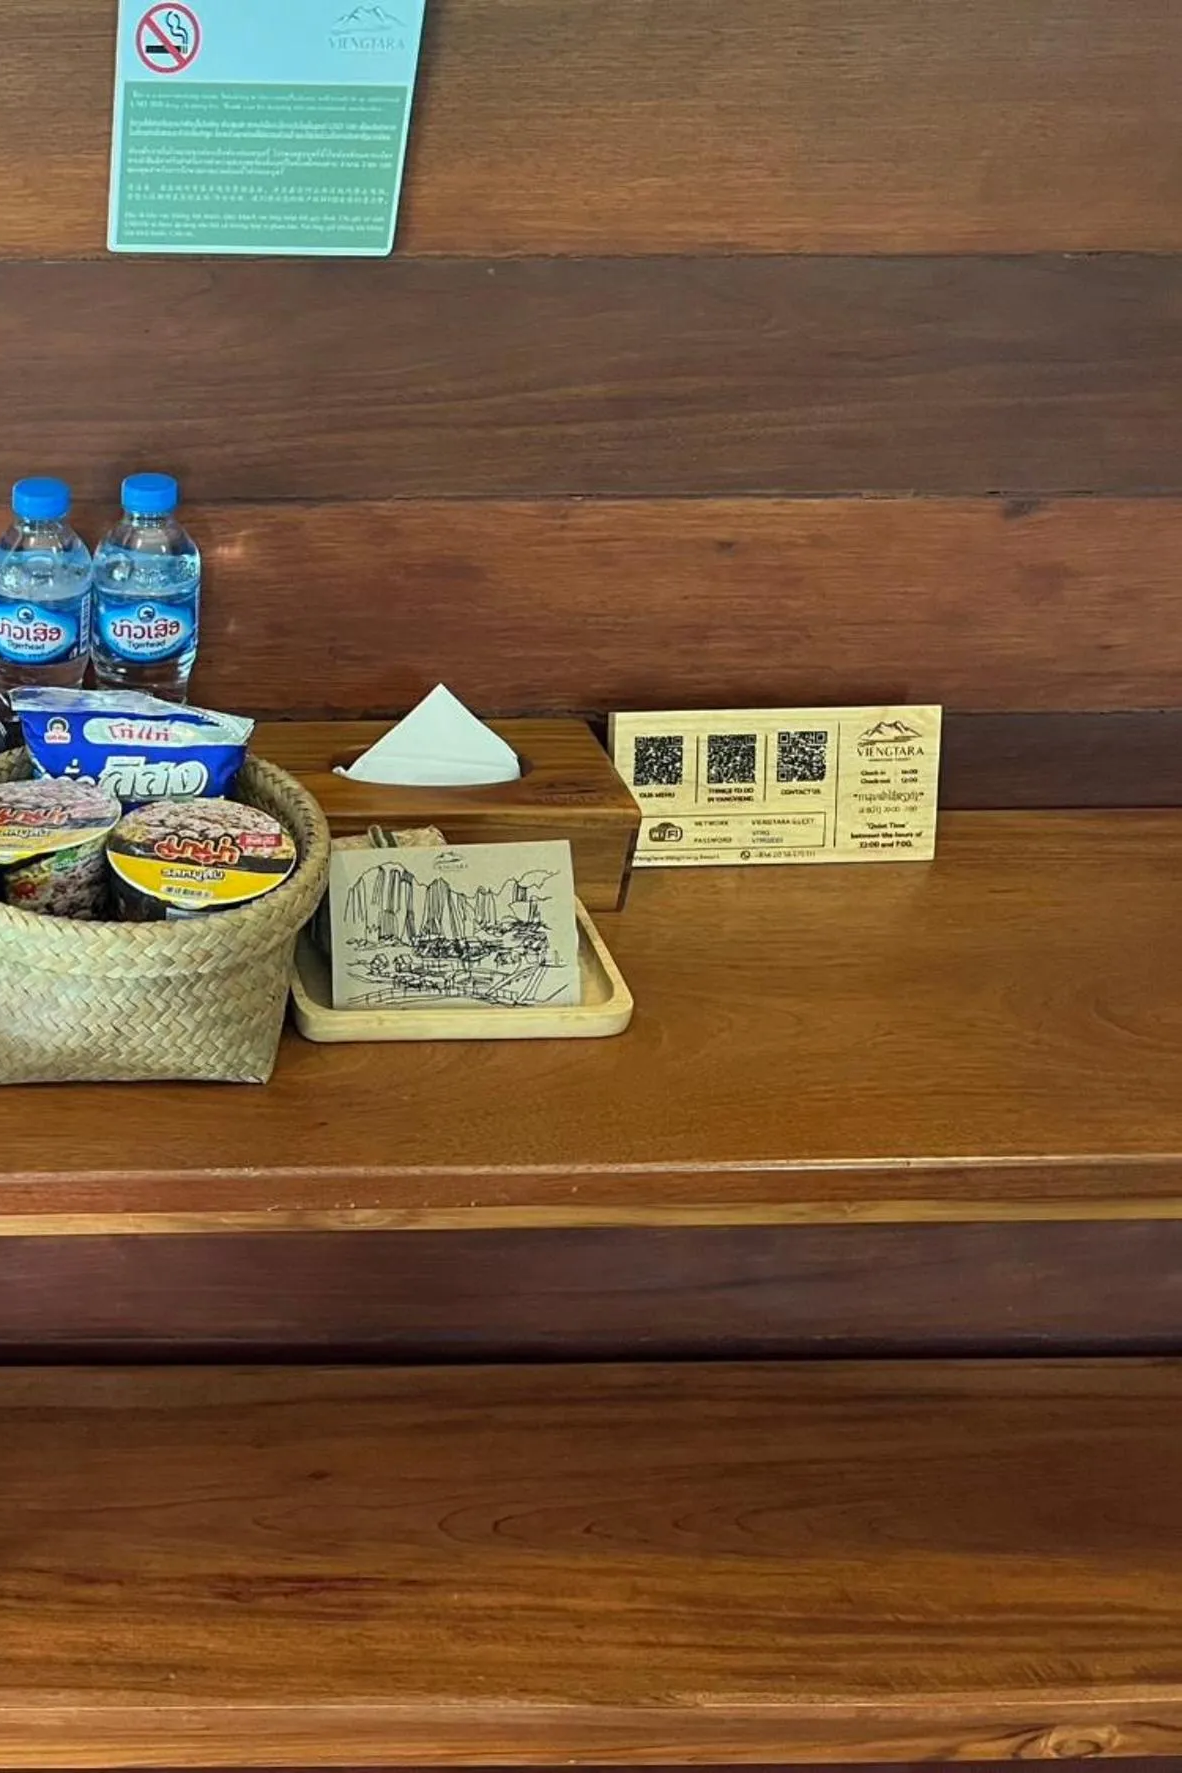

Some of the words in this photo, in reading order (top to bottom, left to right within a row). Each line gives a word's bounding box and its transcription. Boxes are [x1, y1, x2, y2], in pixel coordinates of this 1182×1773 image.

[328, 37, 406, 51] VIENGTARA
[6, 639, 45, 650] Tigerhead
[127, 638, 167, 650] Tigerhead
[856, 746, 925, 757] VIENGTARA
[780, 788, 807, 796] CONTACT
